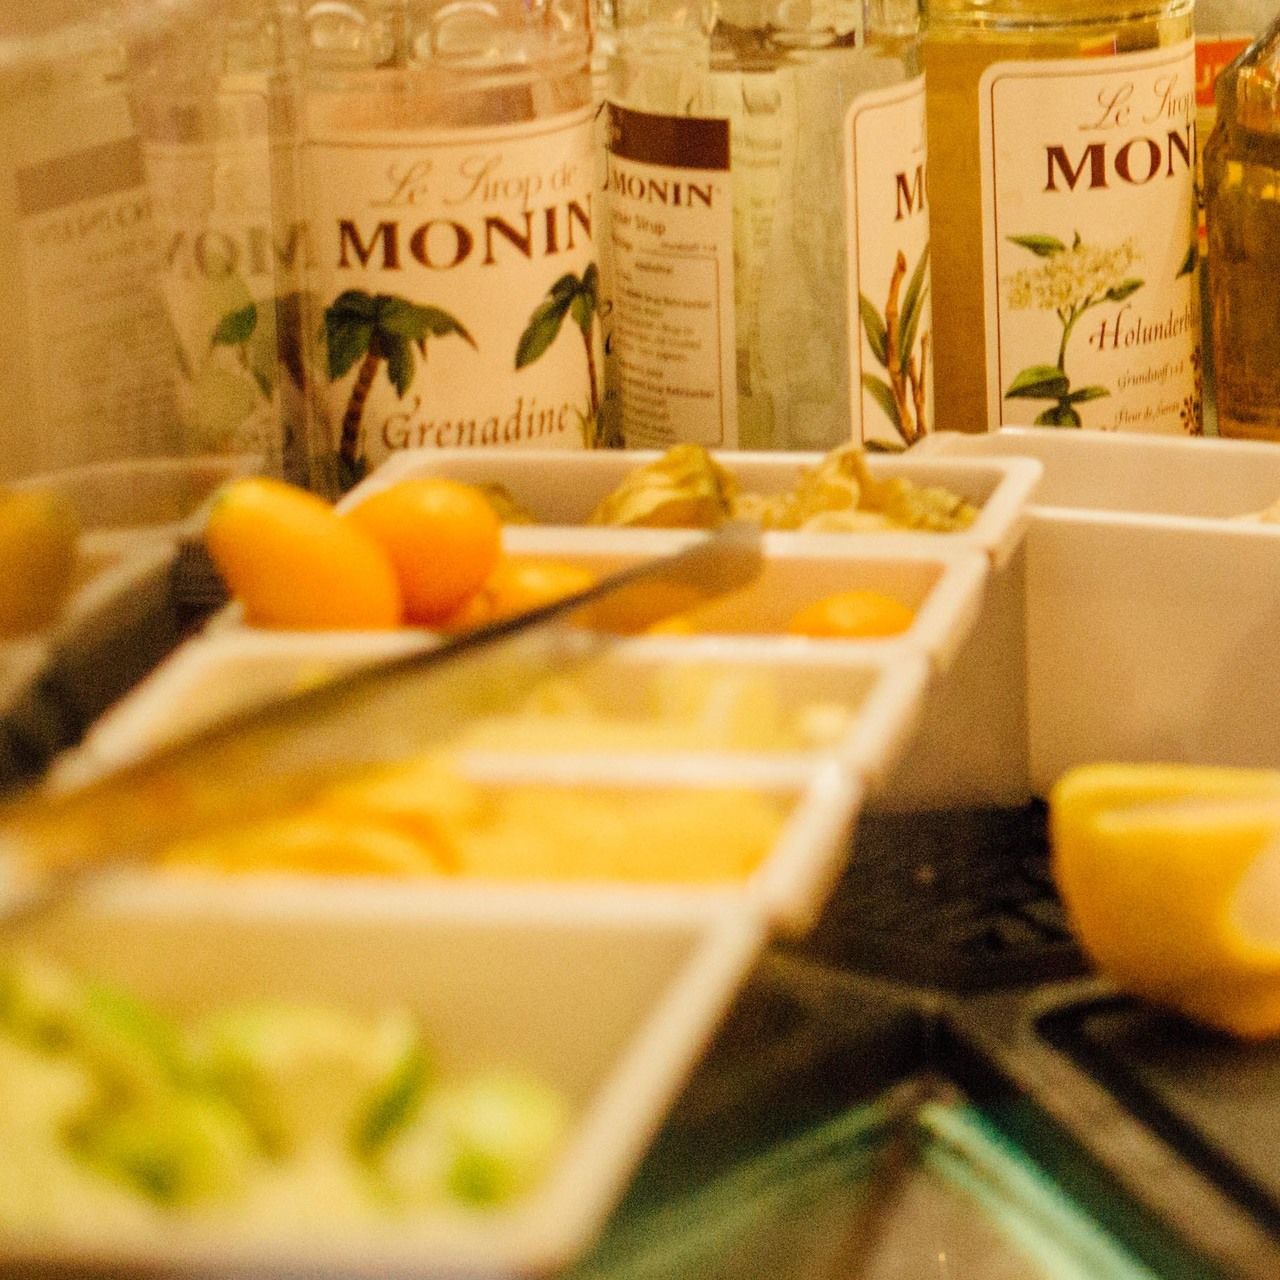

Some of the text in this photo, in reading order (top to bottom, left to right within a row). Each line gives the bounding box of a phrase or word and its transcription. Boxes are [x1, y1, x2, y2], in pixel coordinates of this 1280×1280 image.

[1078, 81, 1131, 132] Le
[368, 158, 433, 209] Le
[442, 153, 544, 210] Sirop
[1043, 120, 1198, 192] MON
[610, 169, 714, 208] MONIN
[337, 193, 593, 271] MONIN
[381, 395, 571, 449] Grenadine
